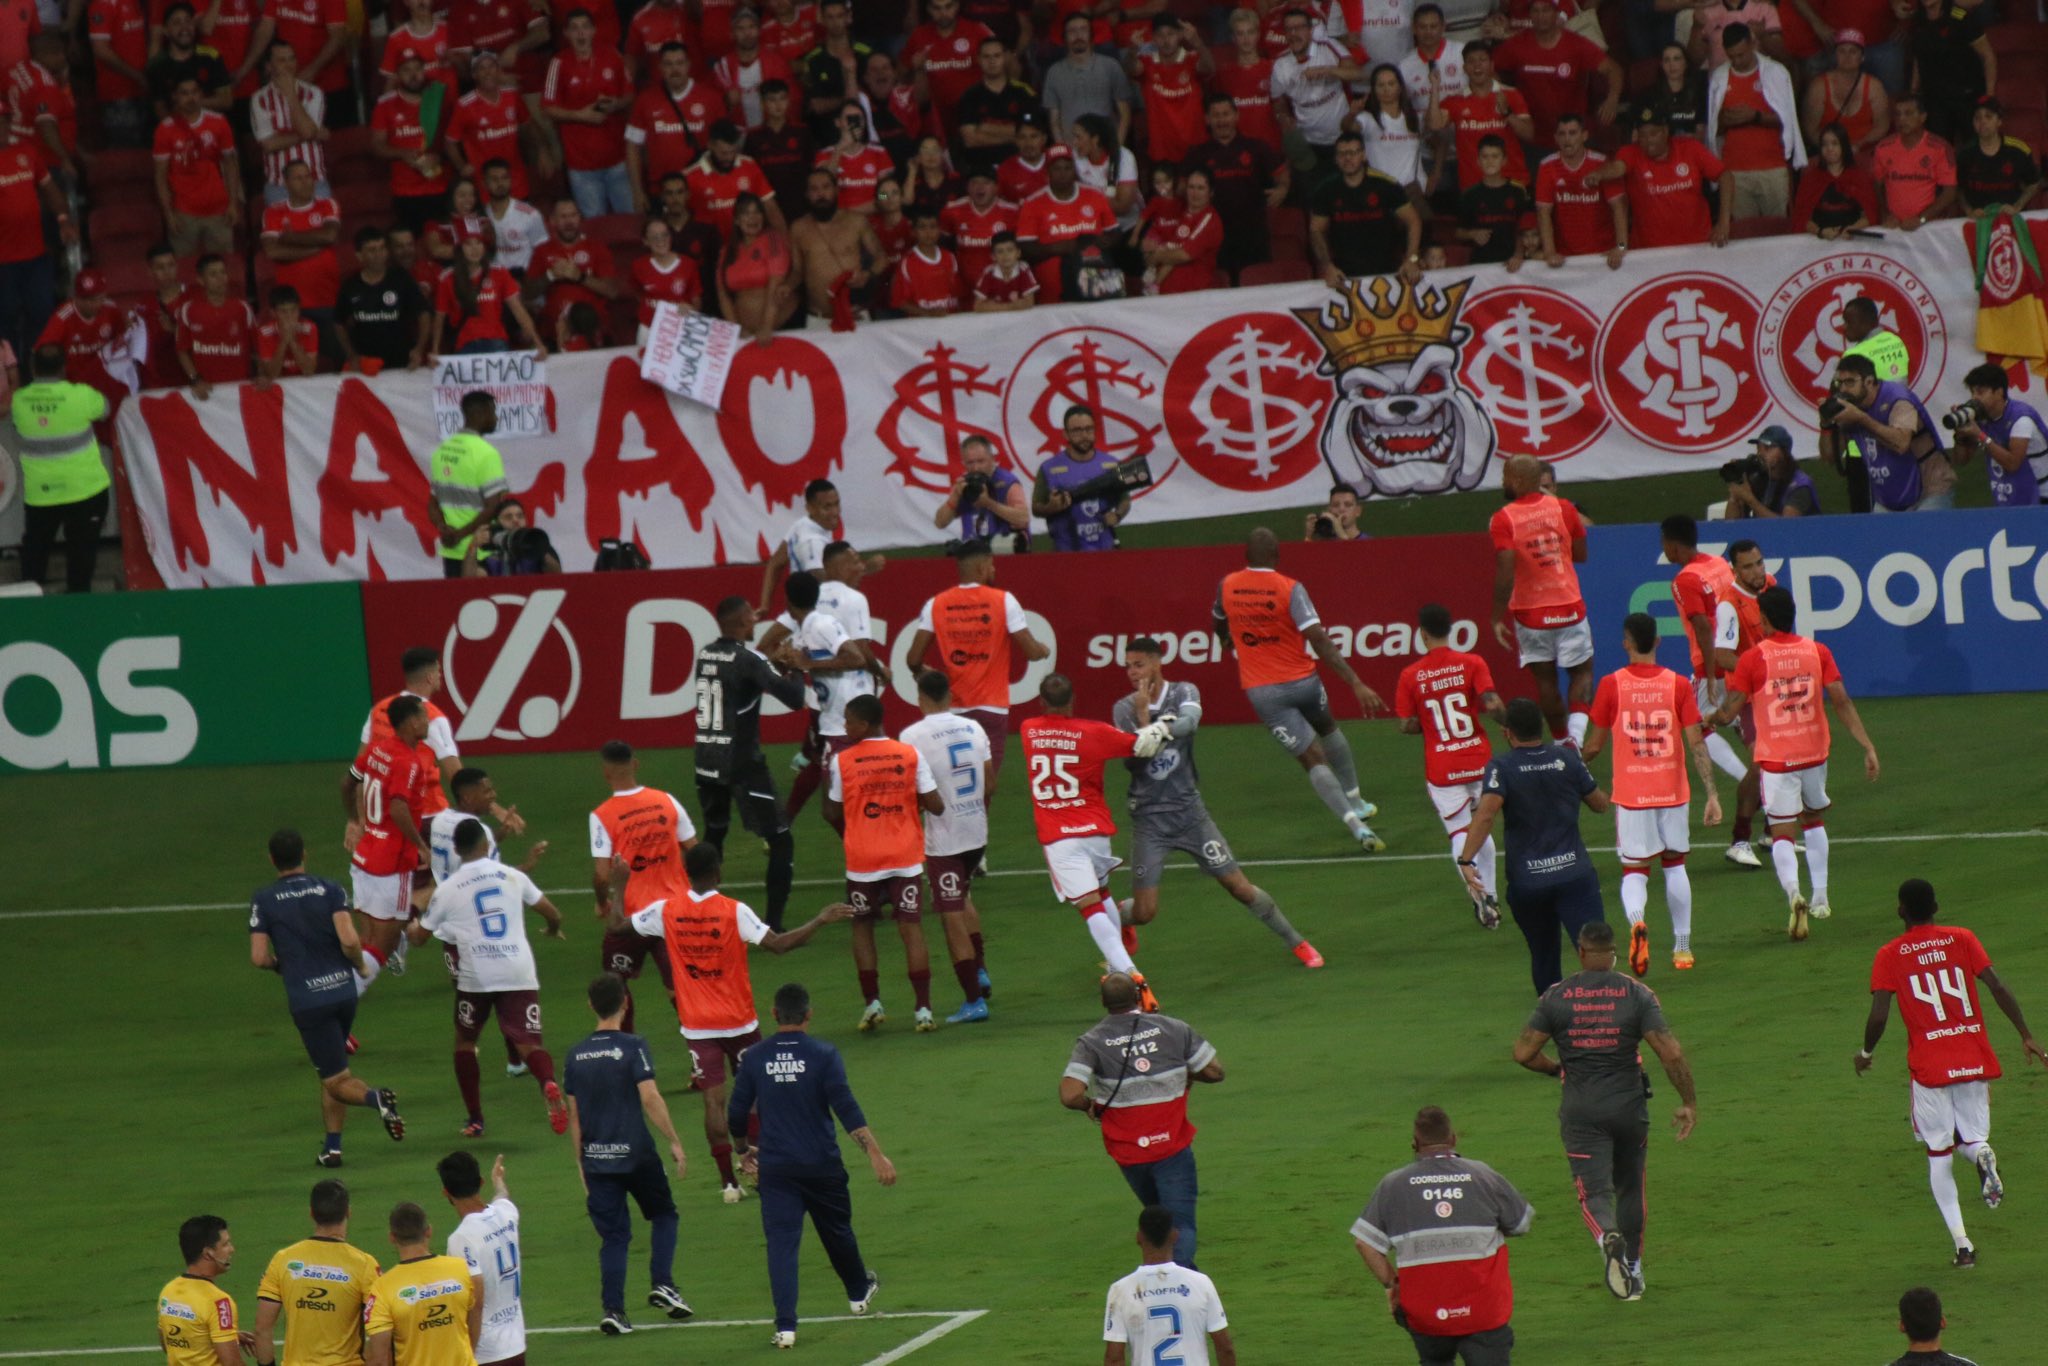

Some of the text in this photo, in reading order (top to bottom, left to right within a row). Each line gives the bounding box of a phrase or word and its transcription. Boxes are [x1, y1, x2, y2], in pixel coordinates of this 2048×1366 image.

[1362, 16, 1400, 26] anrisul
[192, 339, 241, 357] Banrisul
[1427, 663, 1465, 679] banrisul
[1431, 675, 1465, 691] BUSTOS
[695, 678, 724, 731] 31
[1631, 692, 1664, 704] FELIPE
[1425, 692, 1475, 743] 16
[1038, 728, 1082, 740] banrisul
[1031, 738, 1077, 751] MERCADO
[947, 741, 978, 798] 5
[1031, 753, 1080, 801] 25
[1447, 766, 1486, 782] Unimed
[1526, 849, 1577, 869] VINHEDOS
[473, 887, 508, 940] 6
[1911, 934, 1955, 952] banrisul
[1574, 986, 1627, 999] Banrisul
[1909, 966, 1974, 1023] 44
[1572, 1001, 1616, 1012] Unimed
[765, 1060, 807, 1076] CAXIAS
[1948, 1064, 1984, 1079] Unimed
[1409, 1173, 1472, 1185] COORDENADOR
[1422, 1187, 1463, 1201] 0146
[494, 1240, 521, 1301] 4
[295, 1297, 337, 1313] dresch
[1146, 1303, 1186, 1366] 2
